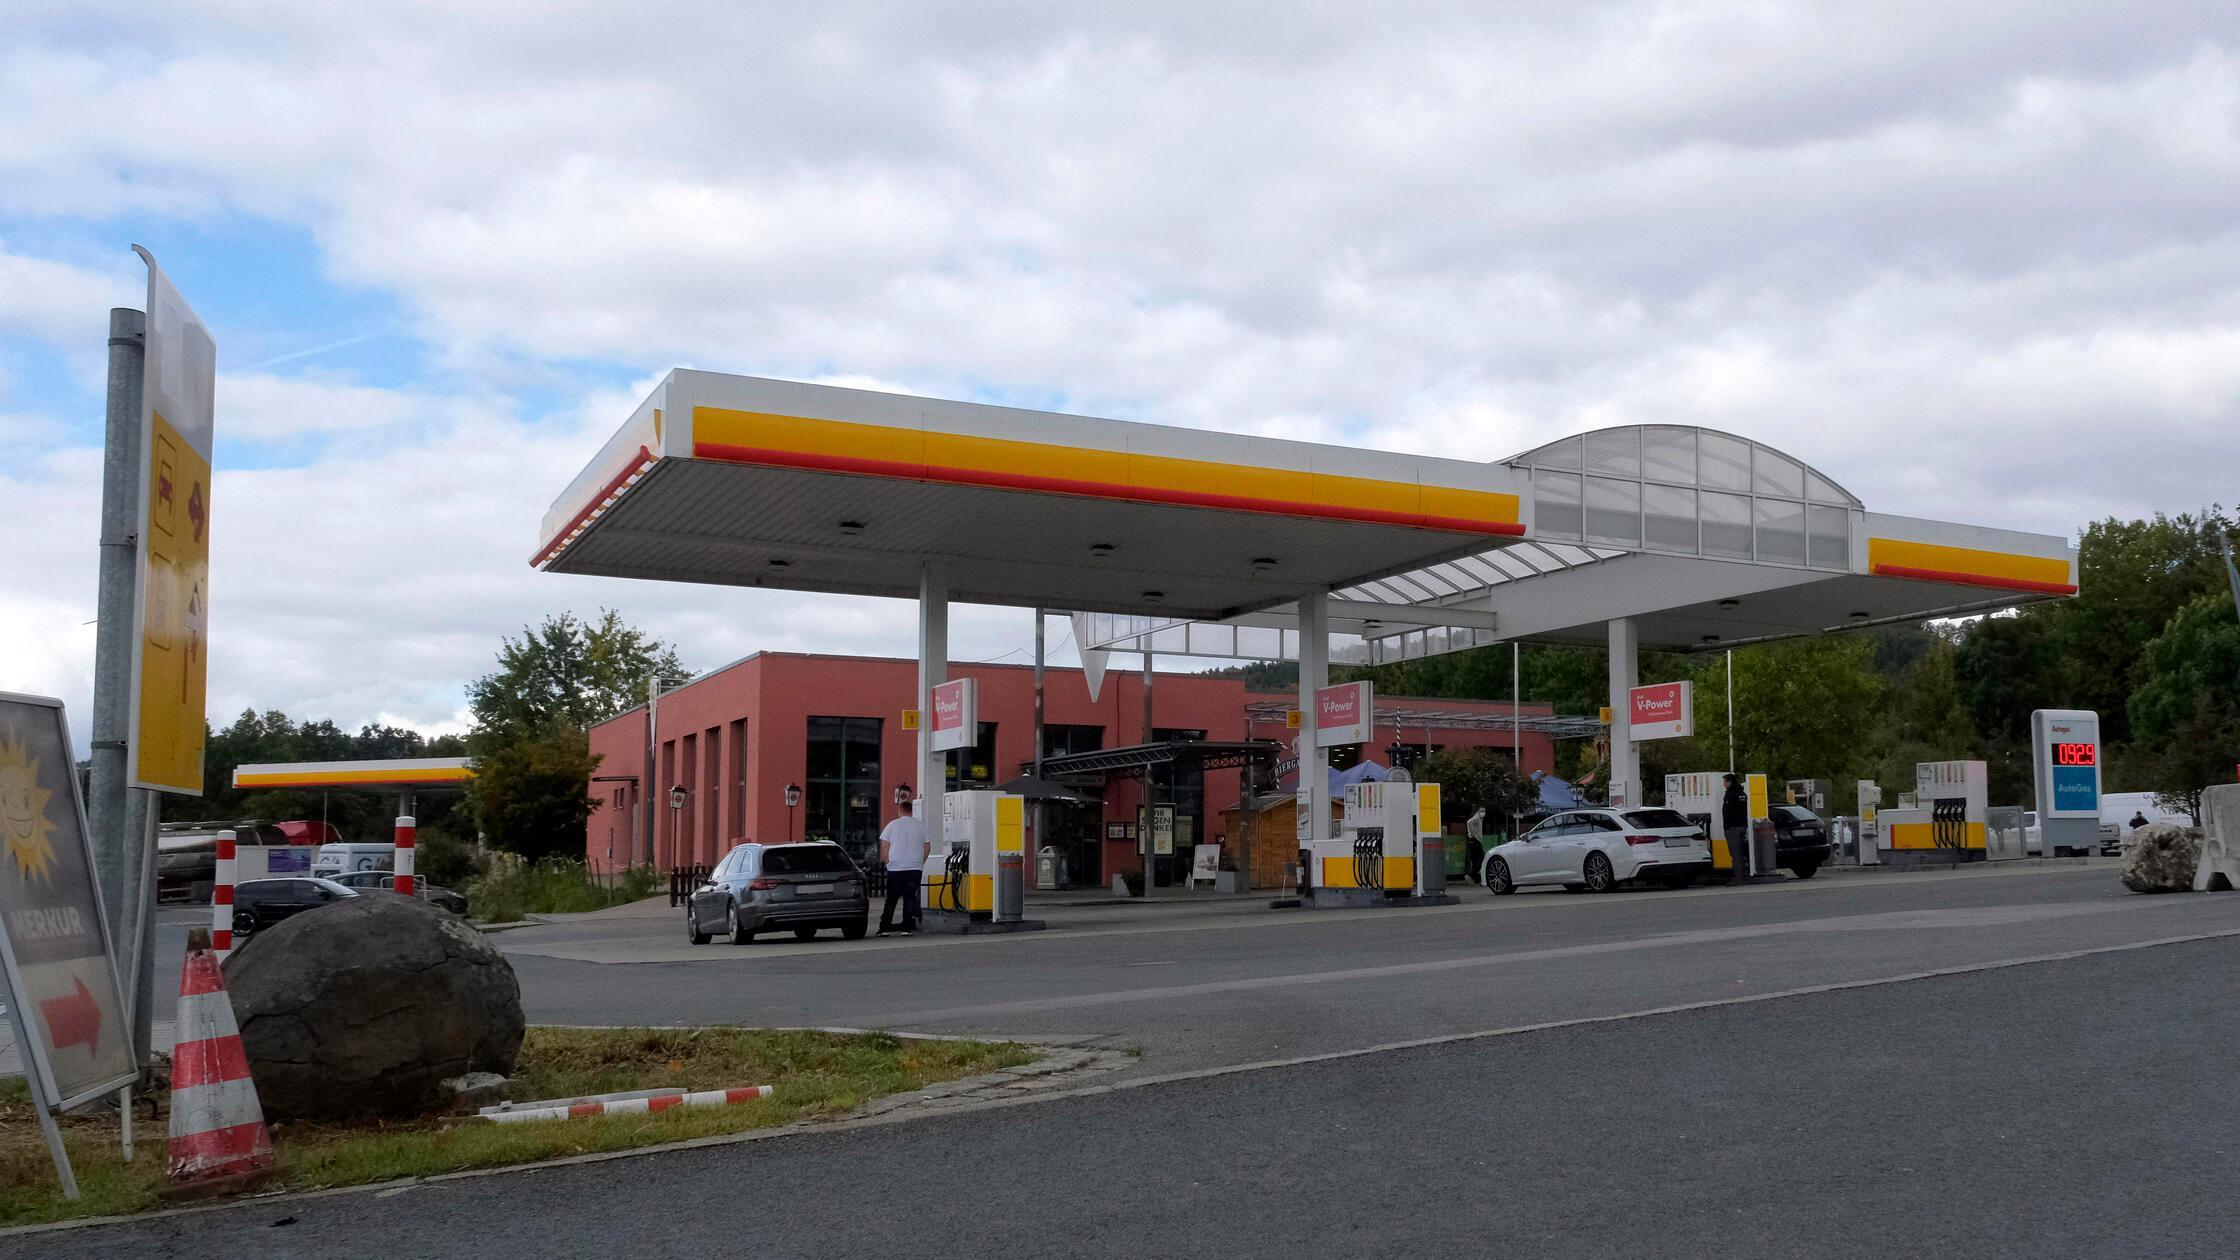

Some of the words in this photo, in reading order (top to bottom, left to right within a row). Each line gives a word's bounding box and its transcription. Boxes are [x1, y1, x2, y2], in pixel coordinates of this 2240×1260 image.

[1323, 701, 1353, 713] V-Power
[1636, 700, 1673, 711] V-Power
[1142, 816, 1171, 825] SGEN
[9, 906, 85, 940] MERKUR
